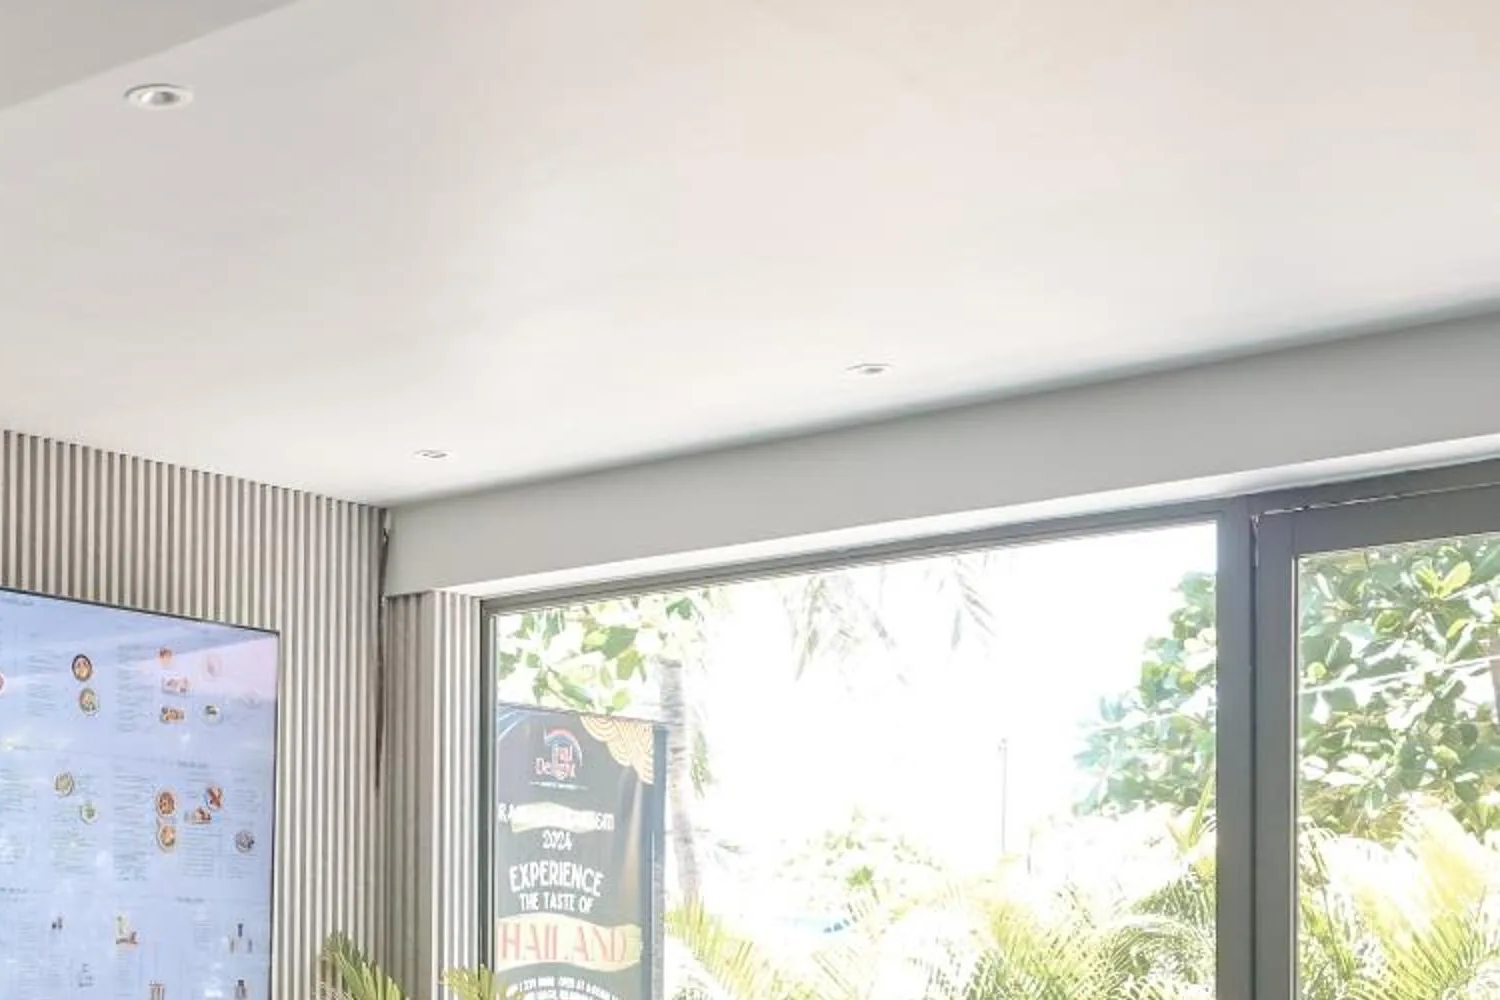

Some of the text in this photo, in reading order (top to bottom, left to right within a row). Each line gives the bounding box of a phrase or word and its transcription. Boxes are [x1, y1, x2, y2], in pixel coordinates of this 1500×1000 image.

[542, 830, 573, 851] 2024
[508, 860, 605, 897] EXPERIENCE
[519, 892, 596, 913] THE TASTE OF
[500, 922, 627, 962] HAILAND
